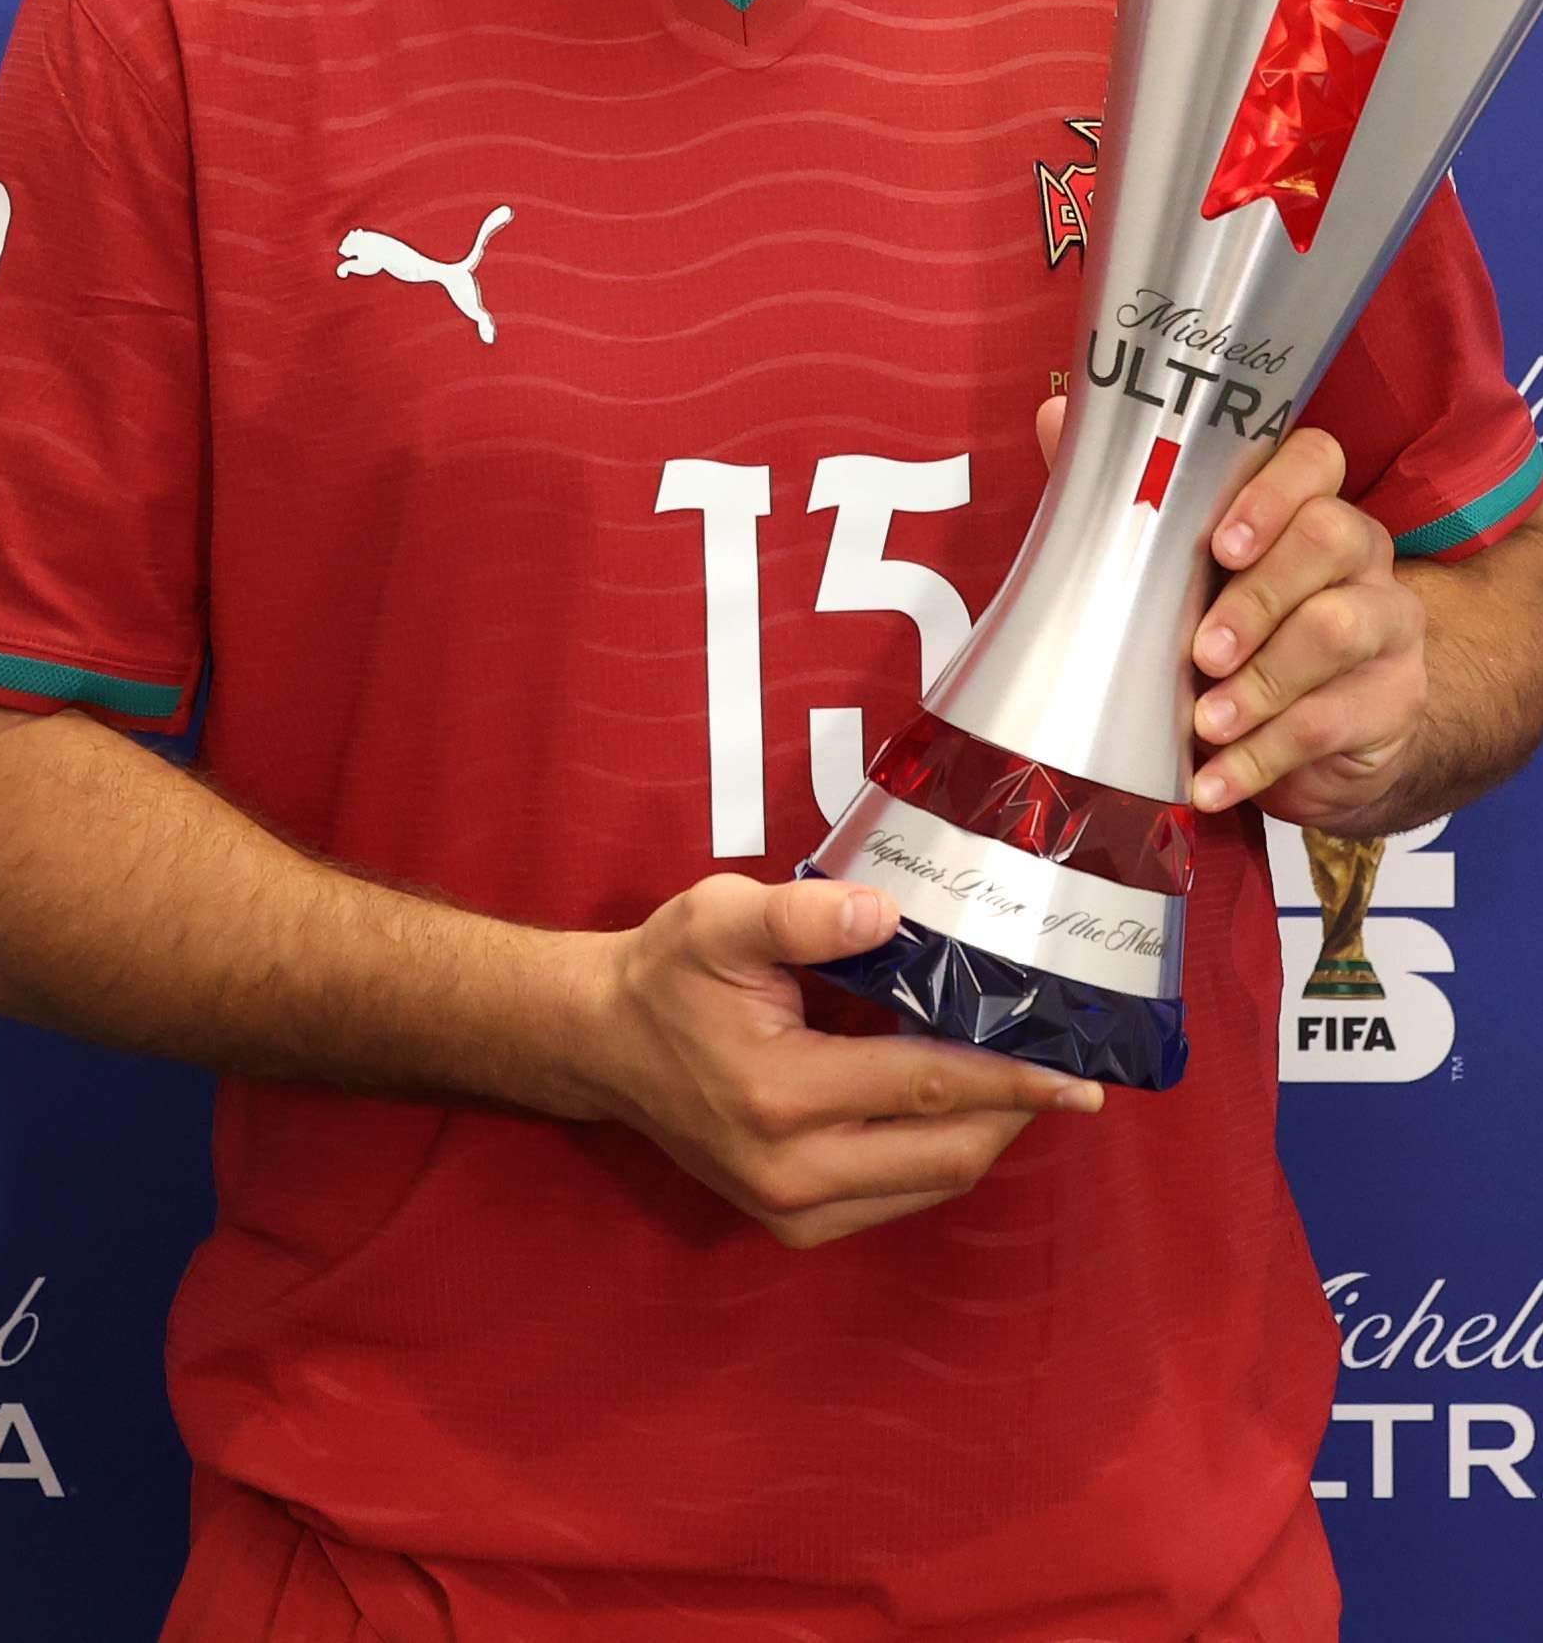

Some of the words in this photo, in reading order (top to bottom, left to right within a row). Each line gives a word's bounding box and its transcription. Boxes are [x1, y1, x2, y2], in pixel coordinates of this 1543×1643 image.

[1087, 329, 1294, 447] ULTRA
[1116, 288, 1294, 375] Michelob
[654, 452, 972, 857] 15
[862, 829, 947, 883] Superior
[1068, 917, 1106, 943] the
[1298, 1019, 1395, 1051] FIFA
